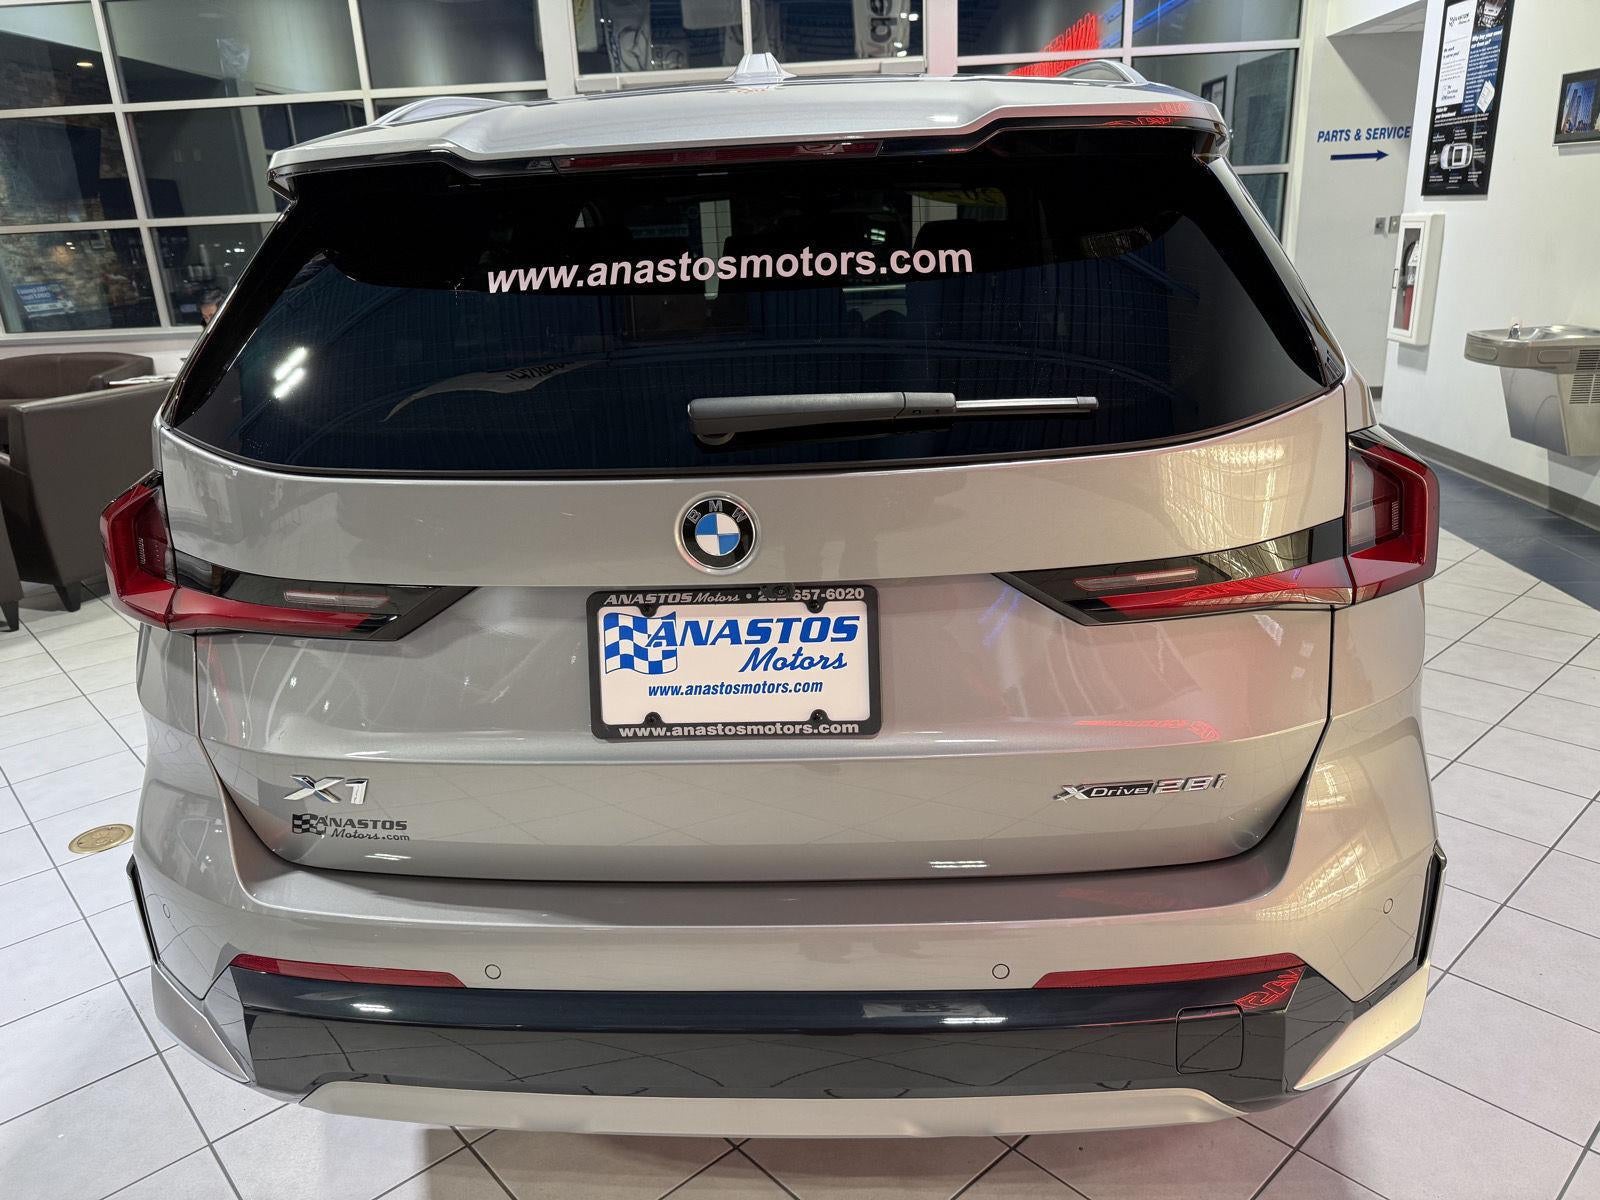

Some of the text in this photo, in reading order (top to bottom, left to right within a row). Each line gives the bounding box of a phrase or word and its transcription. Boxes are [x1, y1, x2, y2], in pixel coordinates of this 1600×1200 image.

[1317, 126, 1411, 142] PARTS & SERVICE
[487, 247, 974, 294] www.anastosmotors.com
[604, 592, 693, 605] ANASTOS
[692, 592, 740, 603] Motors
[645, 616, 860, 648] ANASTOS
[738, 646, 847, 673] Motors
[648, 681, 823, 697] www.anastosmotors.com
[619, 722, 859, 737] www.anastosmotors.com
[283, 774, 369, 805] X1
[315, 815, 408, 831] ANASTOS
[331, 827, 410, 841] Motors.com
